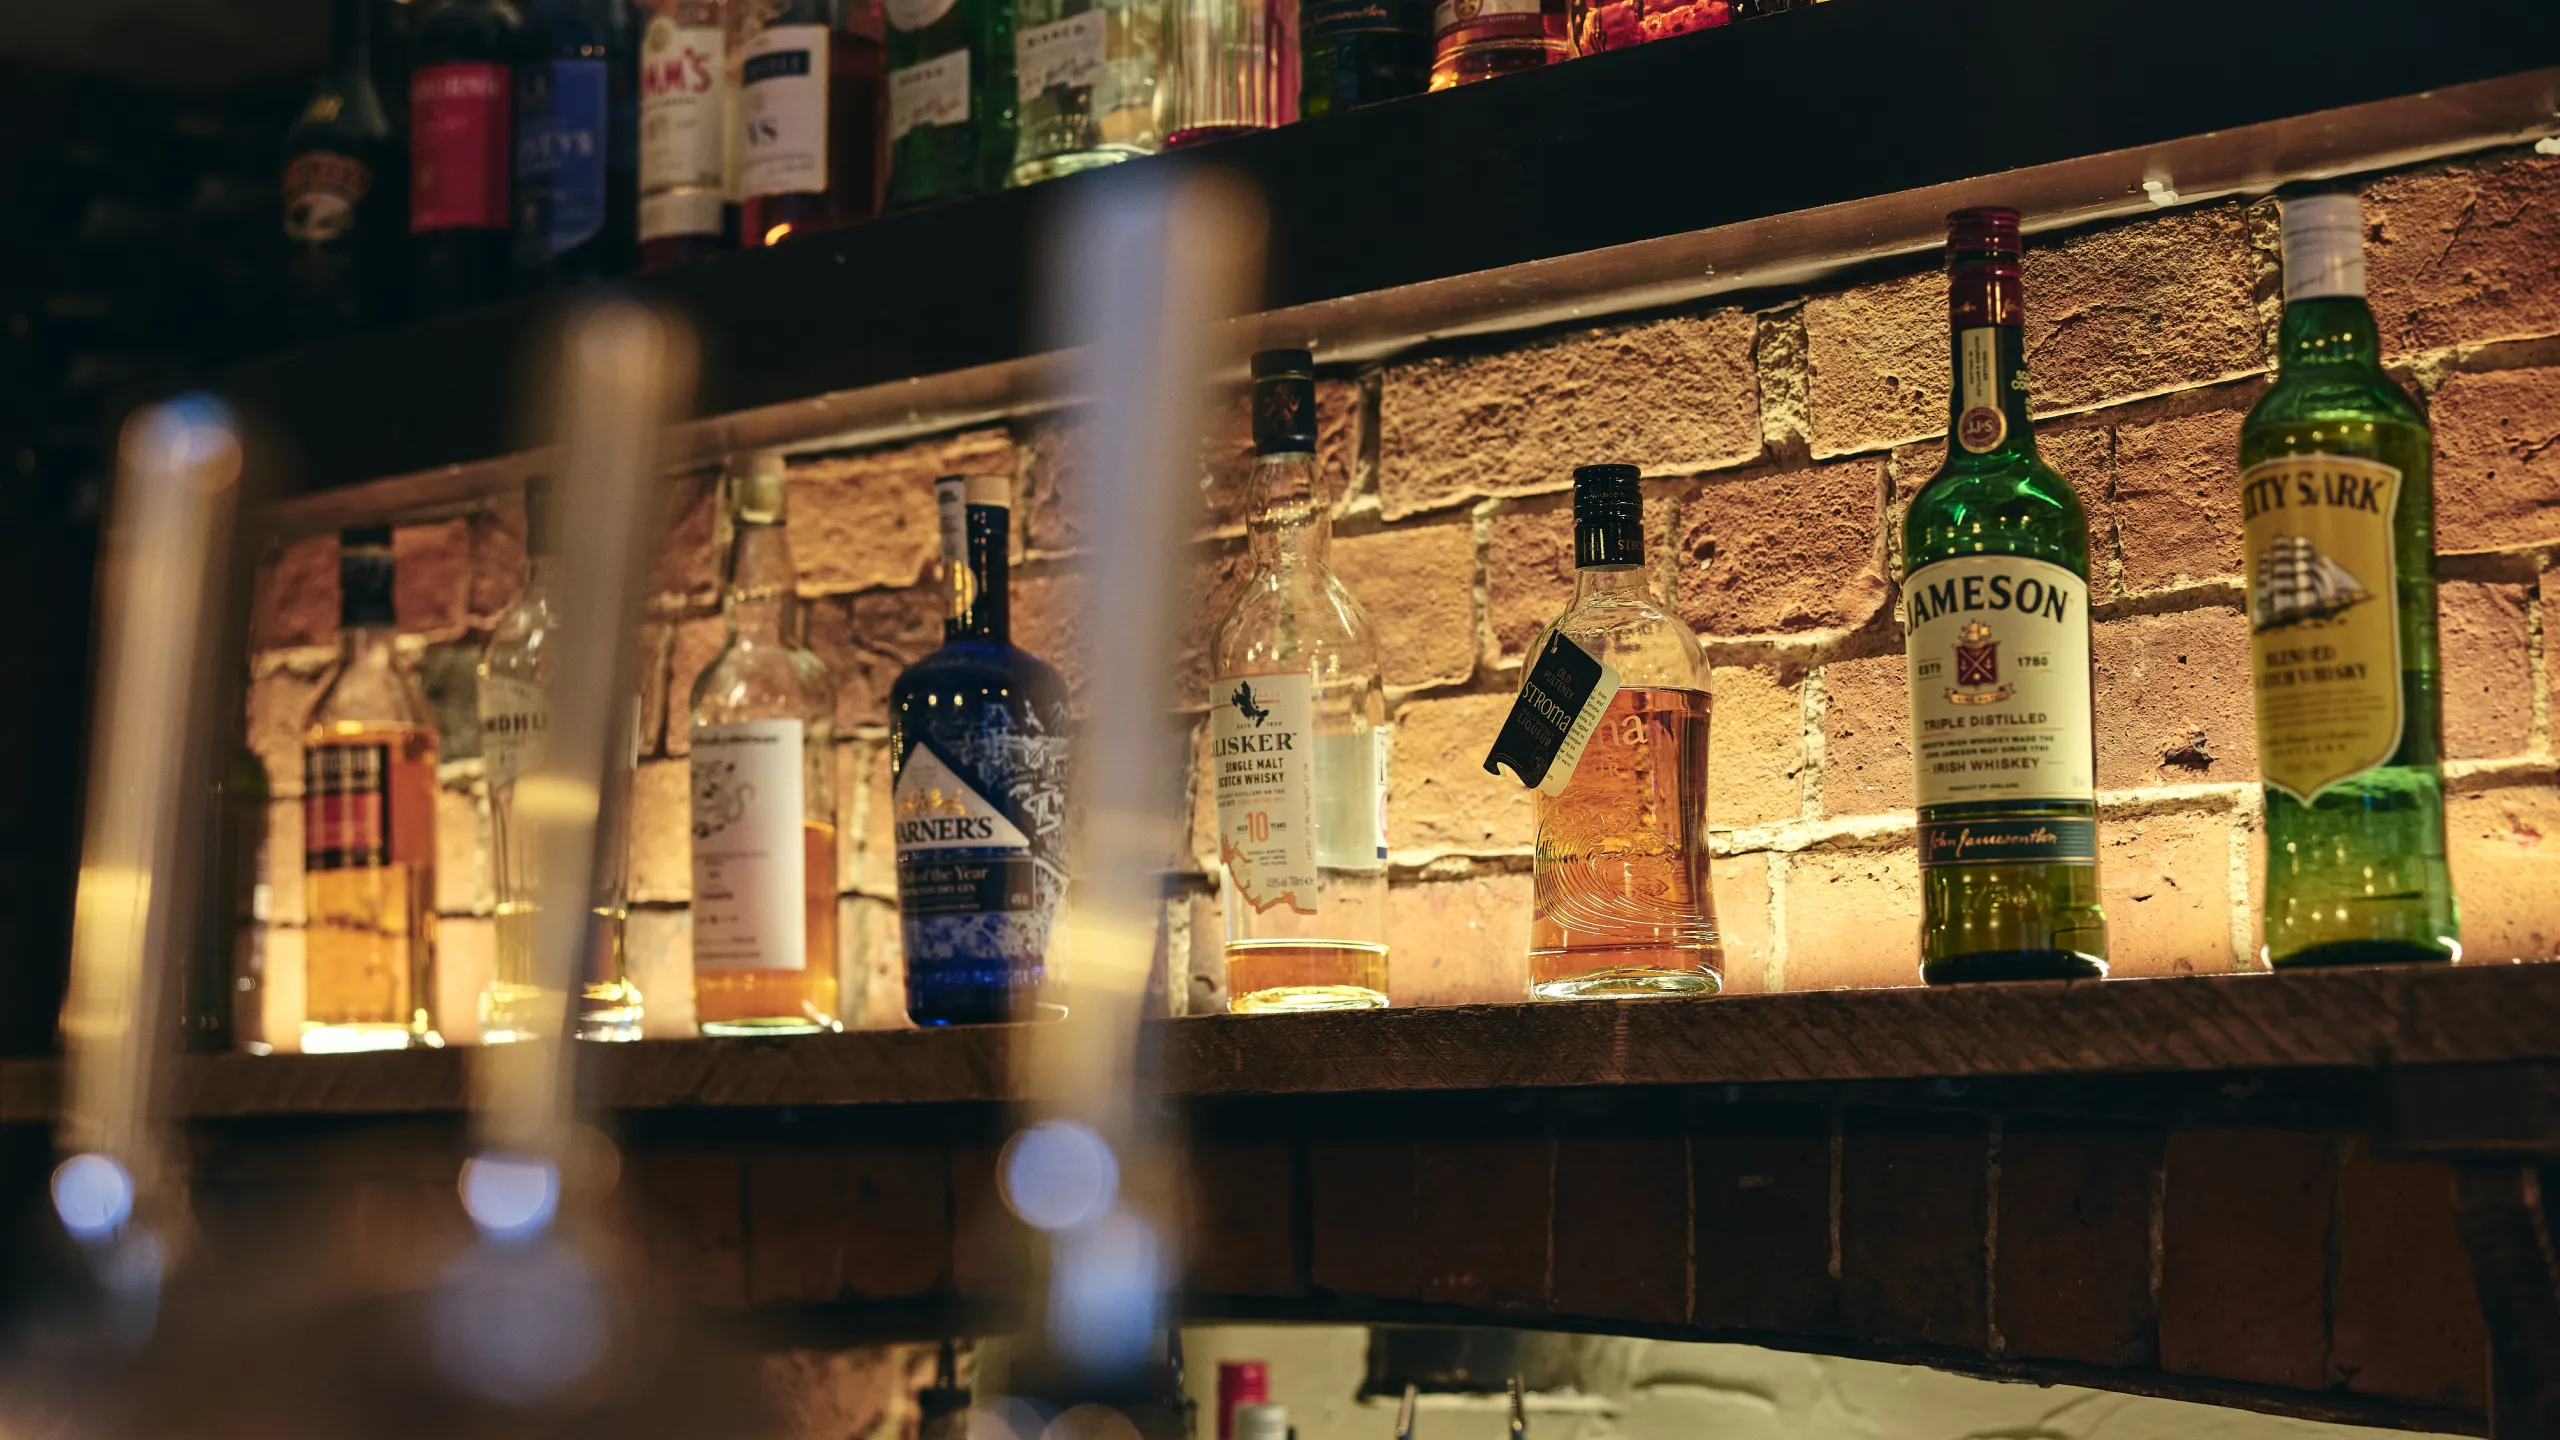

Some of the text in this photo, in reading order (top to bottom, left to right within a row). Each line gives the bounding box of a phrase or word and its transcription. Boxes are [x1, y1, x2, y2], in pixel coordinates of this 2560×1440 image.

[2297, 470, 2385, 514] SARK
[1906, 575, 2068, 637] JAMESON
[2017, 656, 2049, 668] 1780
[1544, 670, 1576, 700] PULTENEY
[1557, 668, 1573, 684] OLD
[1516, 713, 1553, 748] LIQUEUR
[1923, 713, 2048, 731] TRIPLE DISTILLED
[1225, 757, 1284, 774] SINGLE MALT
[1932, 757, 2040, 775] IRISH WHISKEY
[1218, 771, 1285, 789] SCOTCH WHISKY
[1245, 811, 1269, 843] 10
[954, 865, 989, 881] Year
